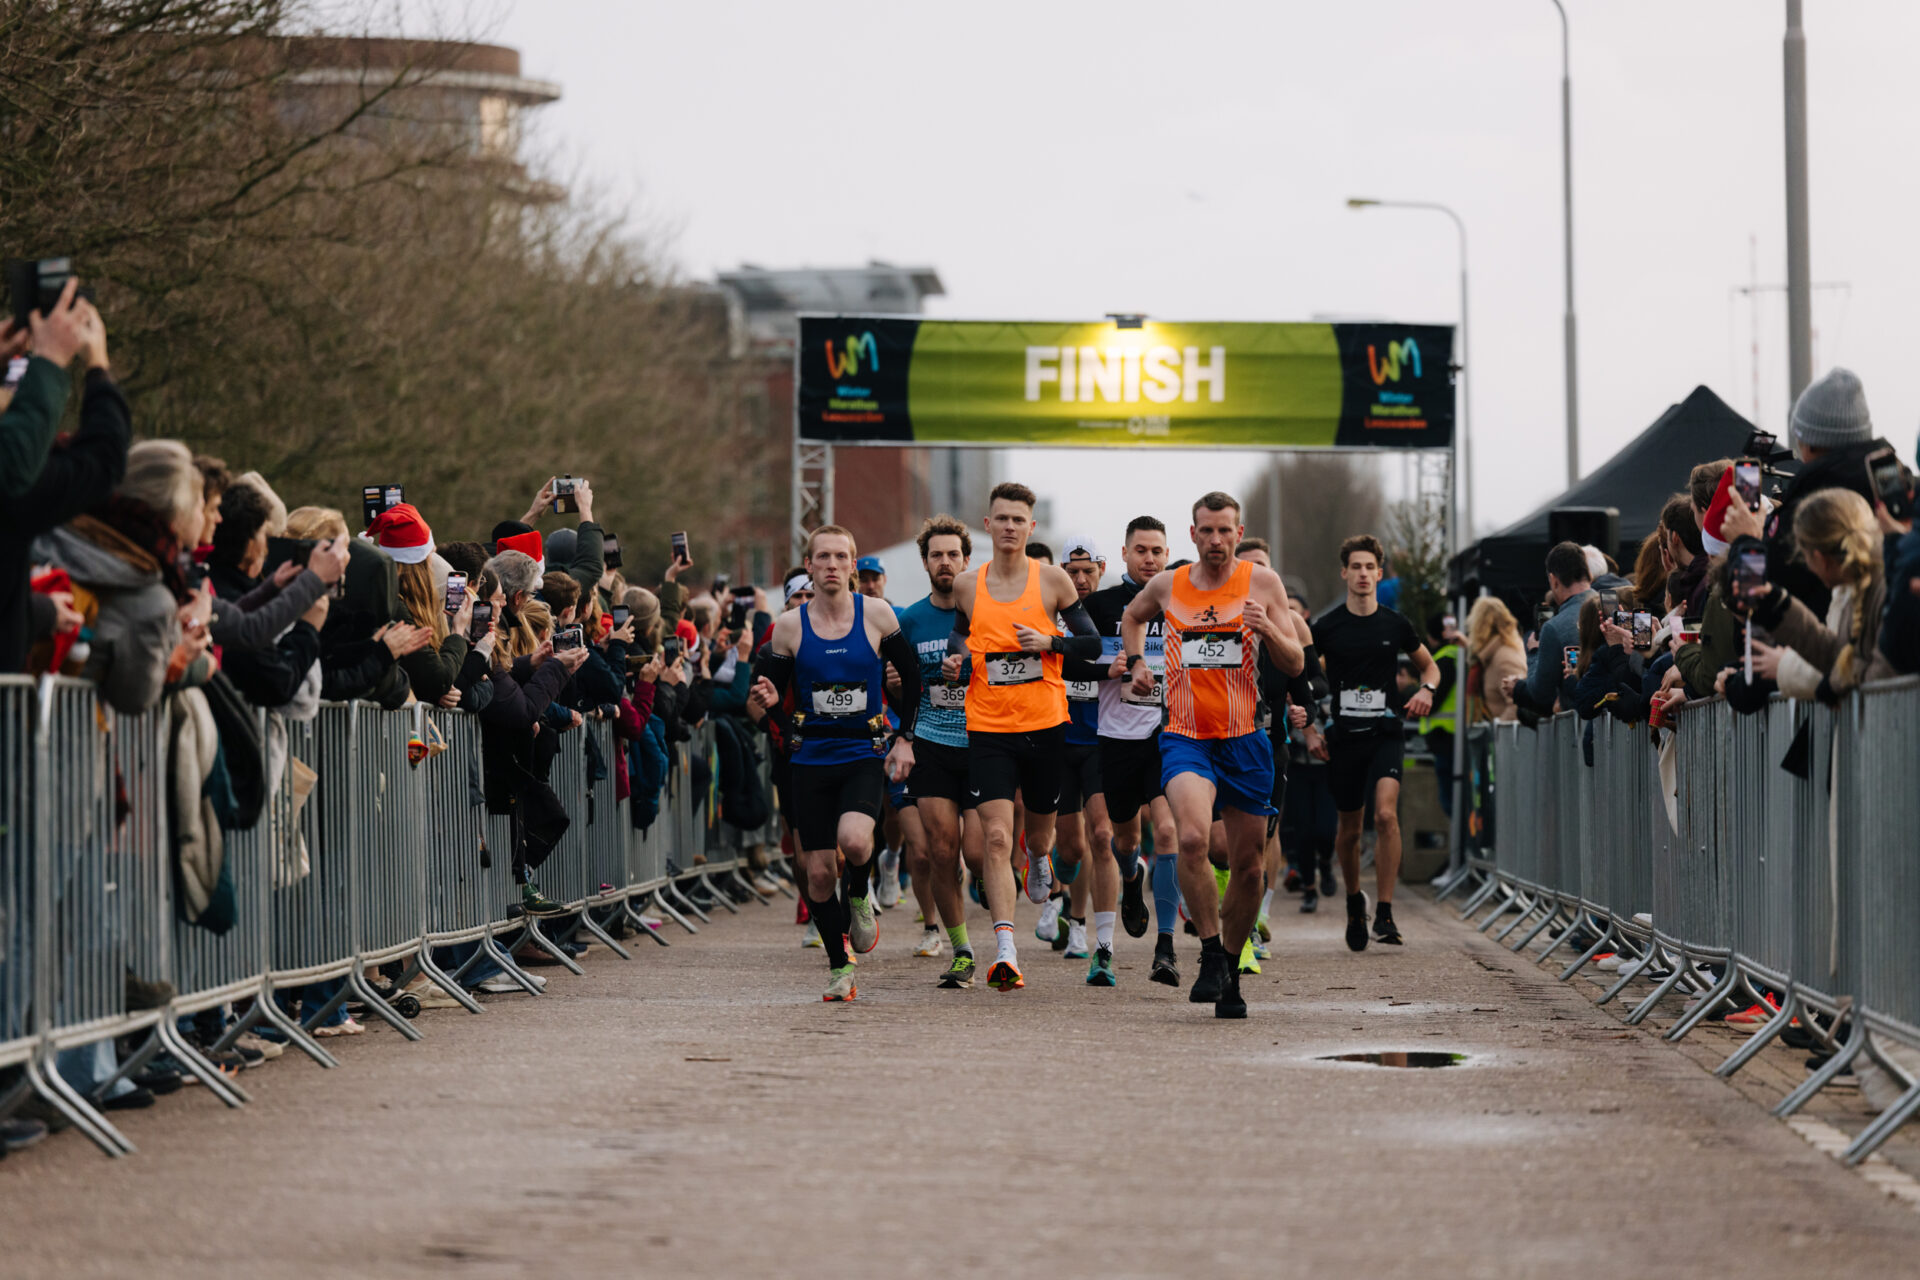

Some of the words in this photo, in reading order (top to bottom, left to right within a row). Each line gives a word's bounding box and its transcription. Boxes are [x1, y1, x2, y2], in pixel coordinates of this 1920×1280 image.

[1025, 346, 1226, 403] FINISH
[1198, 644, 1225, 657] 452
[1001, 662, 1026, 675] 372
[826, 693, 853, 706] 499
[941, 689, 965, 701] 369
[1354, 693, 1373, 704] 159
